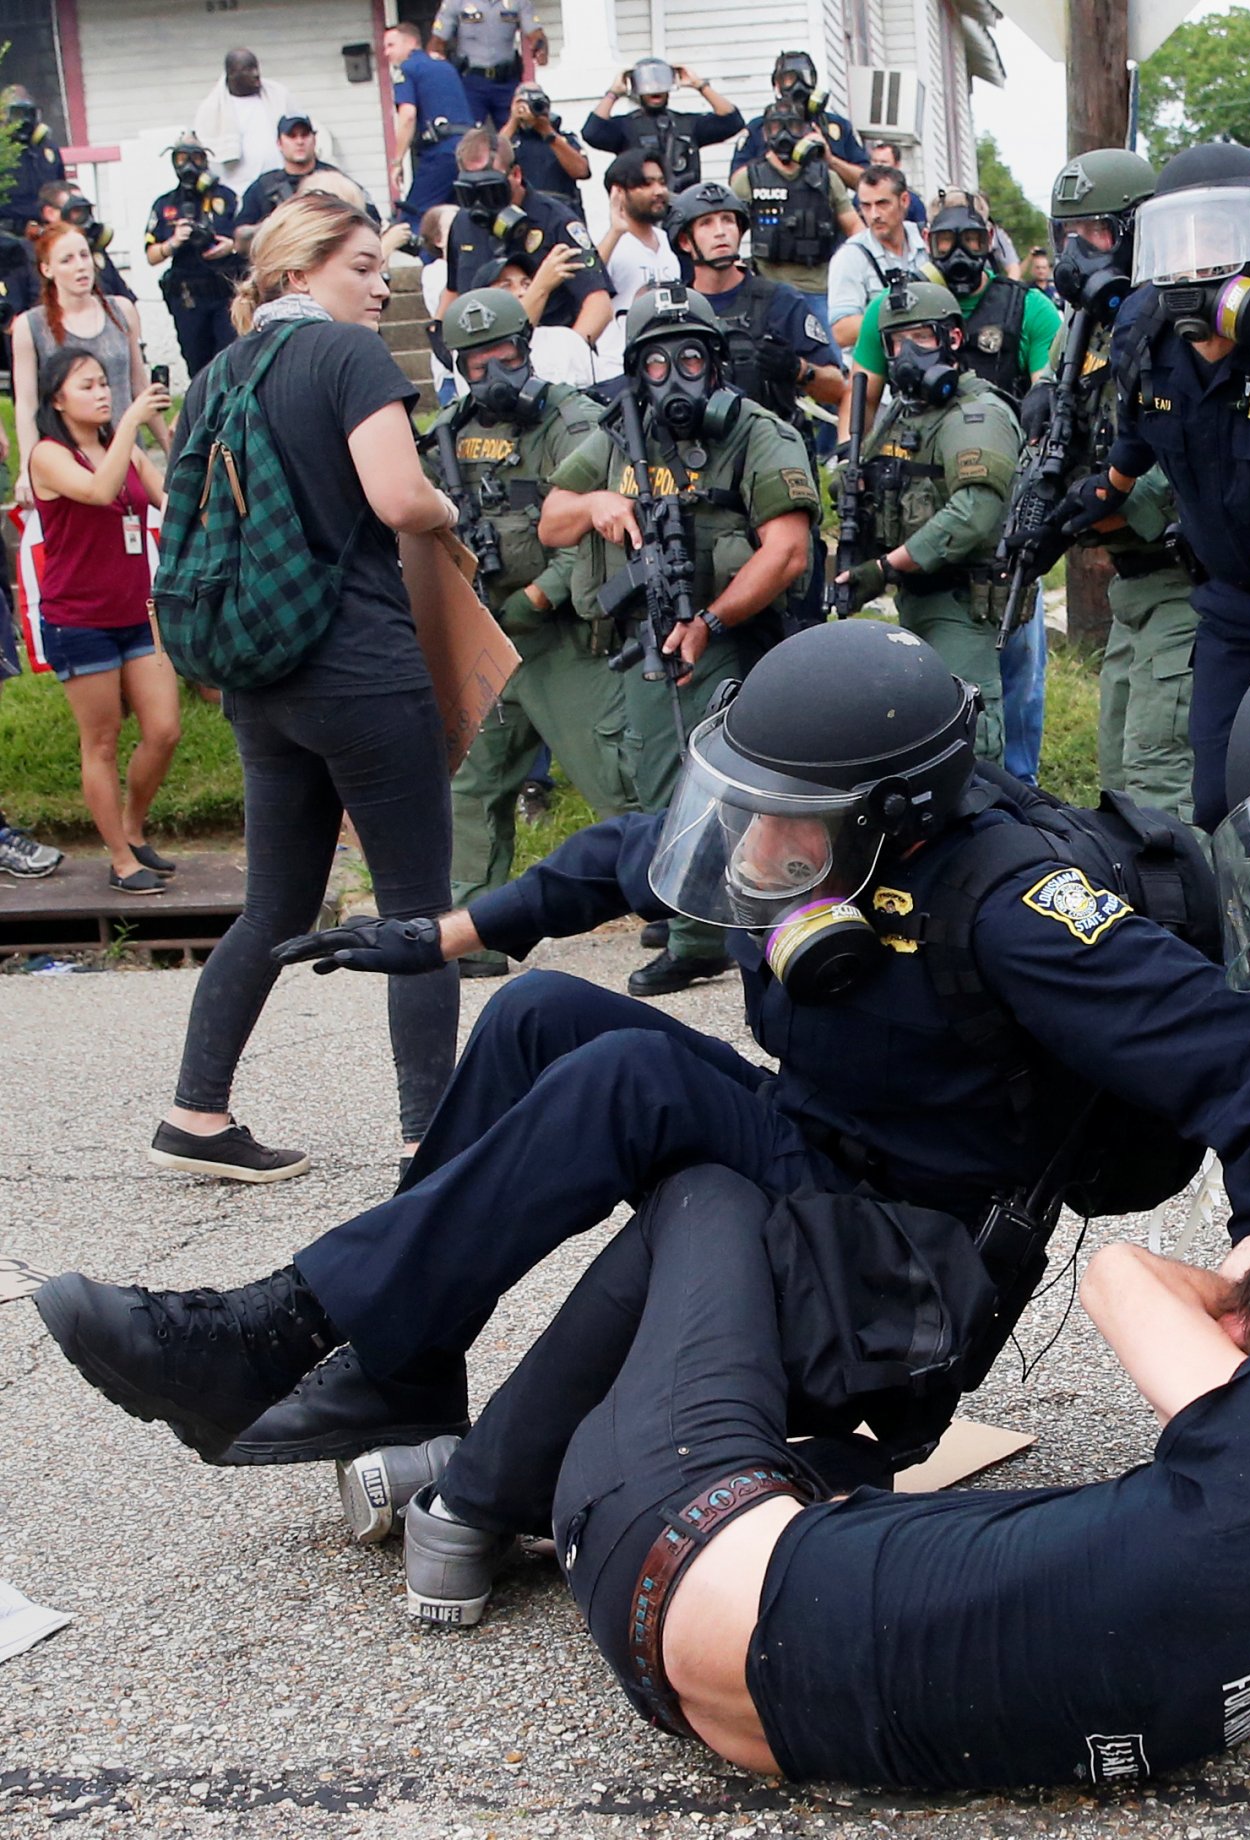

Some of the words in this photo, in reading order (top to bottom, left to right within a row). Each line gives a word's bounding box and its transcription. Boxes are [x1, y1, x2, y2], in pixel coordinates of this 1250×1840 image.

[753, 188, 787, 200] POLICE
[1038, 871, 1081, 908] LOUISIANA
[1074, 911, 1106, 932] STATE
